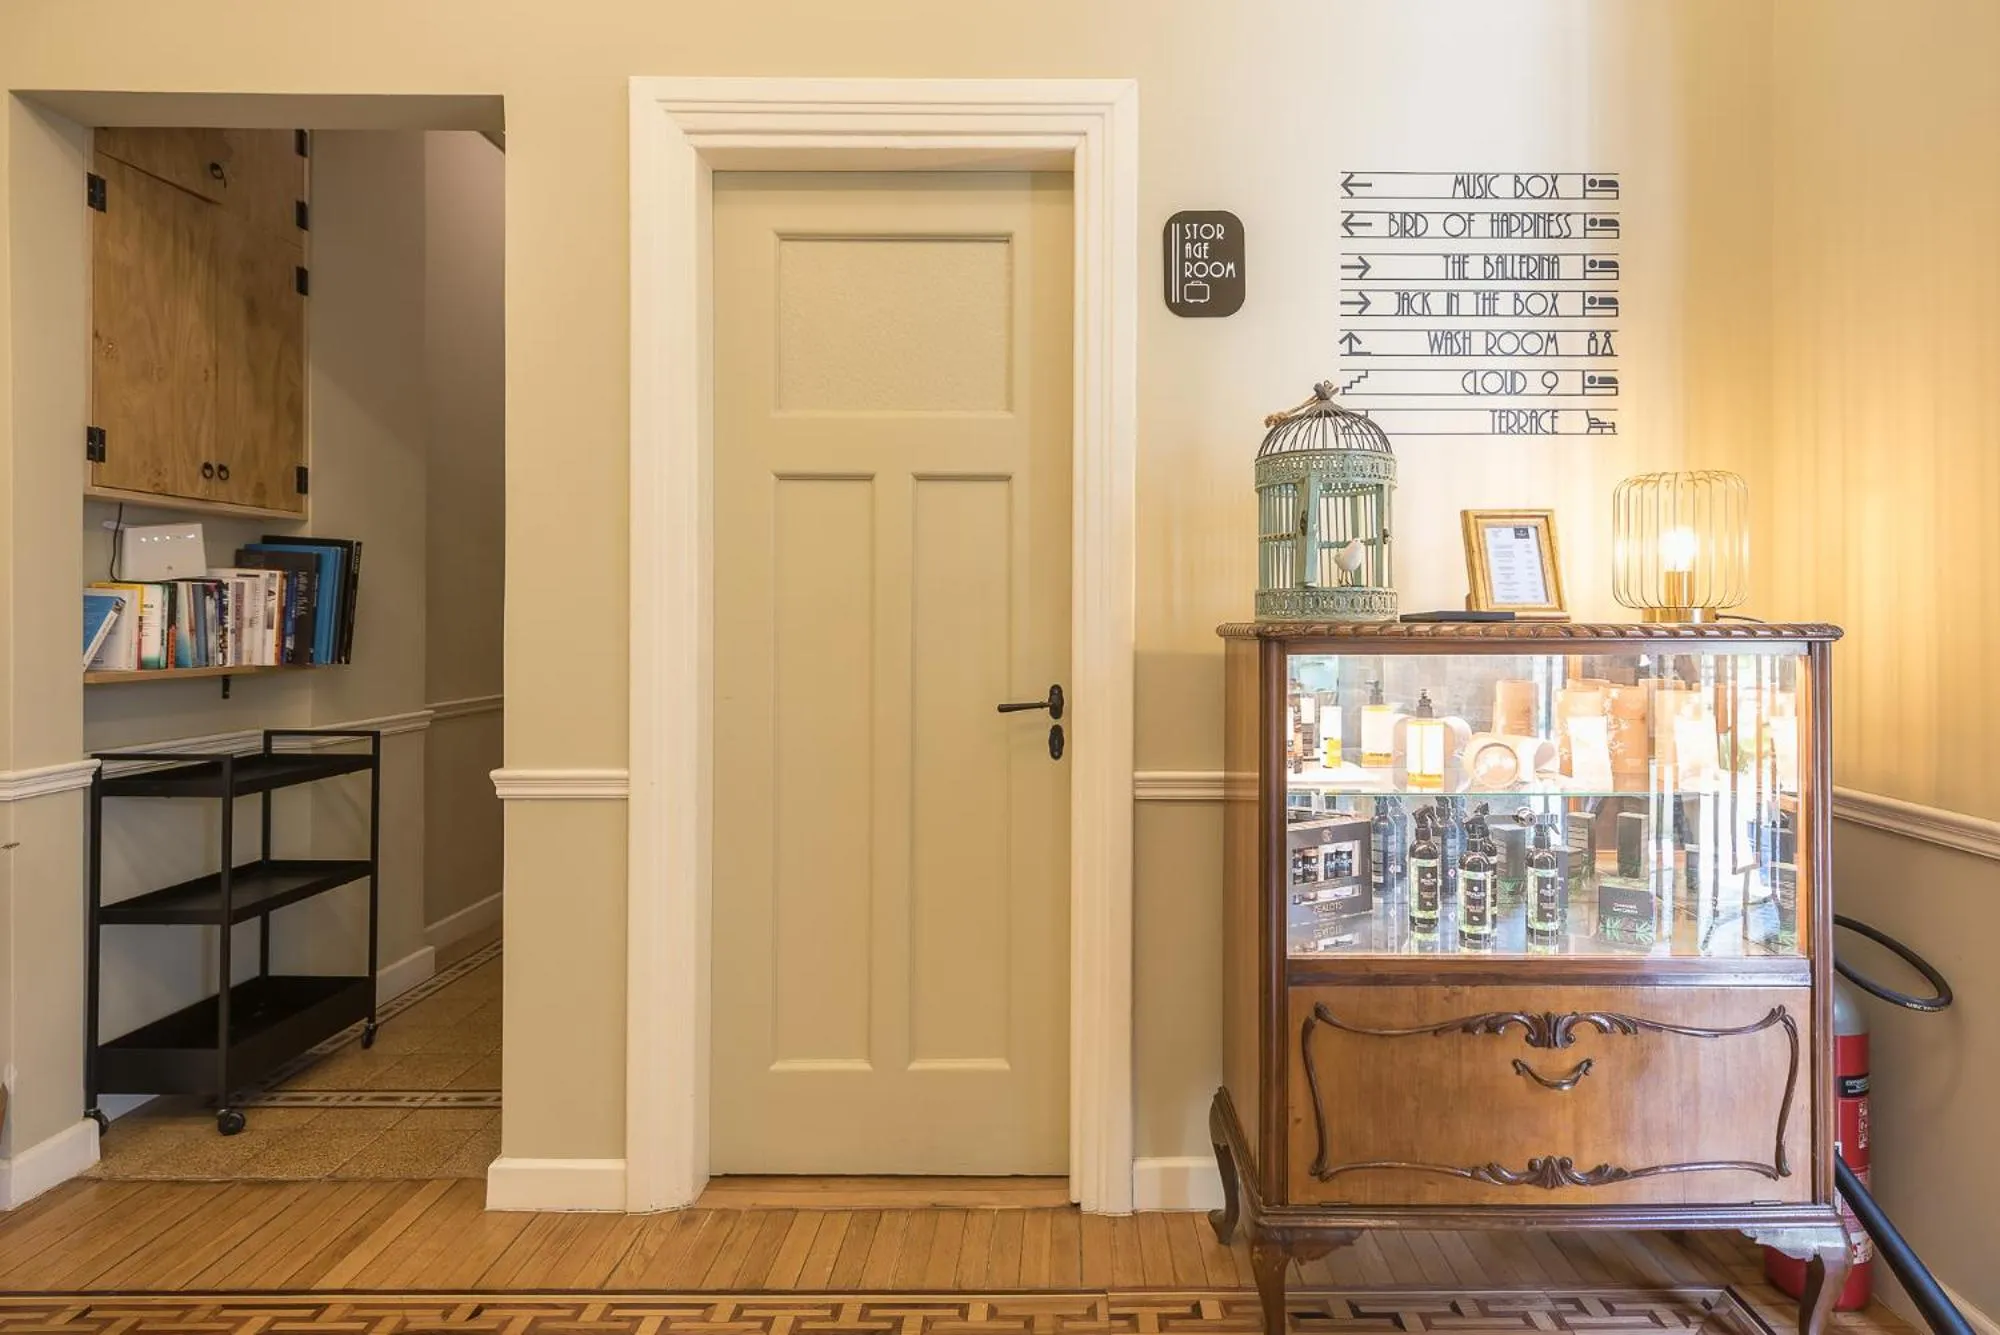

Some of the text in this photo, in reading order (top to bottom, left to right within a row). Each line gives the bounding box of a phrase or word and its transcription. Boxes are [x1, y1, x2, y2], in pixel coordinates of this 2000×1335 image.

[1451, 174, 1560, 199] MUSIC BOX
[1184, 223, 1225, 240] STOR
[1388, 213, 1572, 239] BIRD OF HAPPINESS
[1184, 242, 1210, 259] AGE
[1184, 261, 1237, 278] ROOM
[1443, 255, 1560, 280] THE BALLERINA
[1394, 291, 1560, 316] JACK IN THE BOX
[1427, 331, 1560, 356] WASH ROOM
[1461, 370, 1560, 395] CLOUD 9
[1489, 409, 1559, 434] TERRACE
